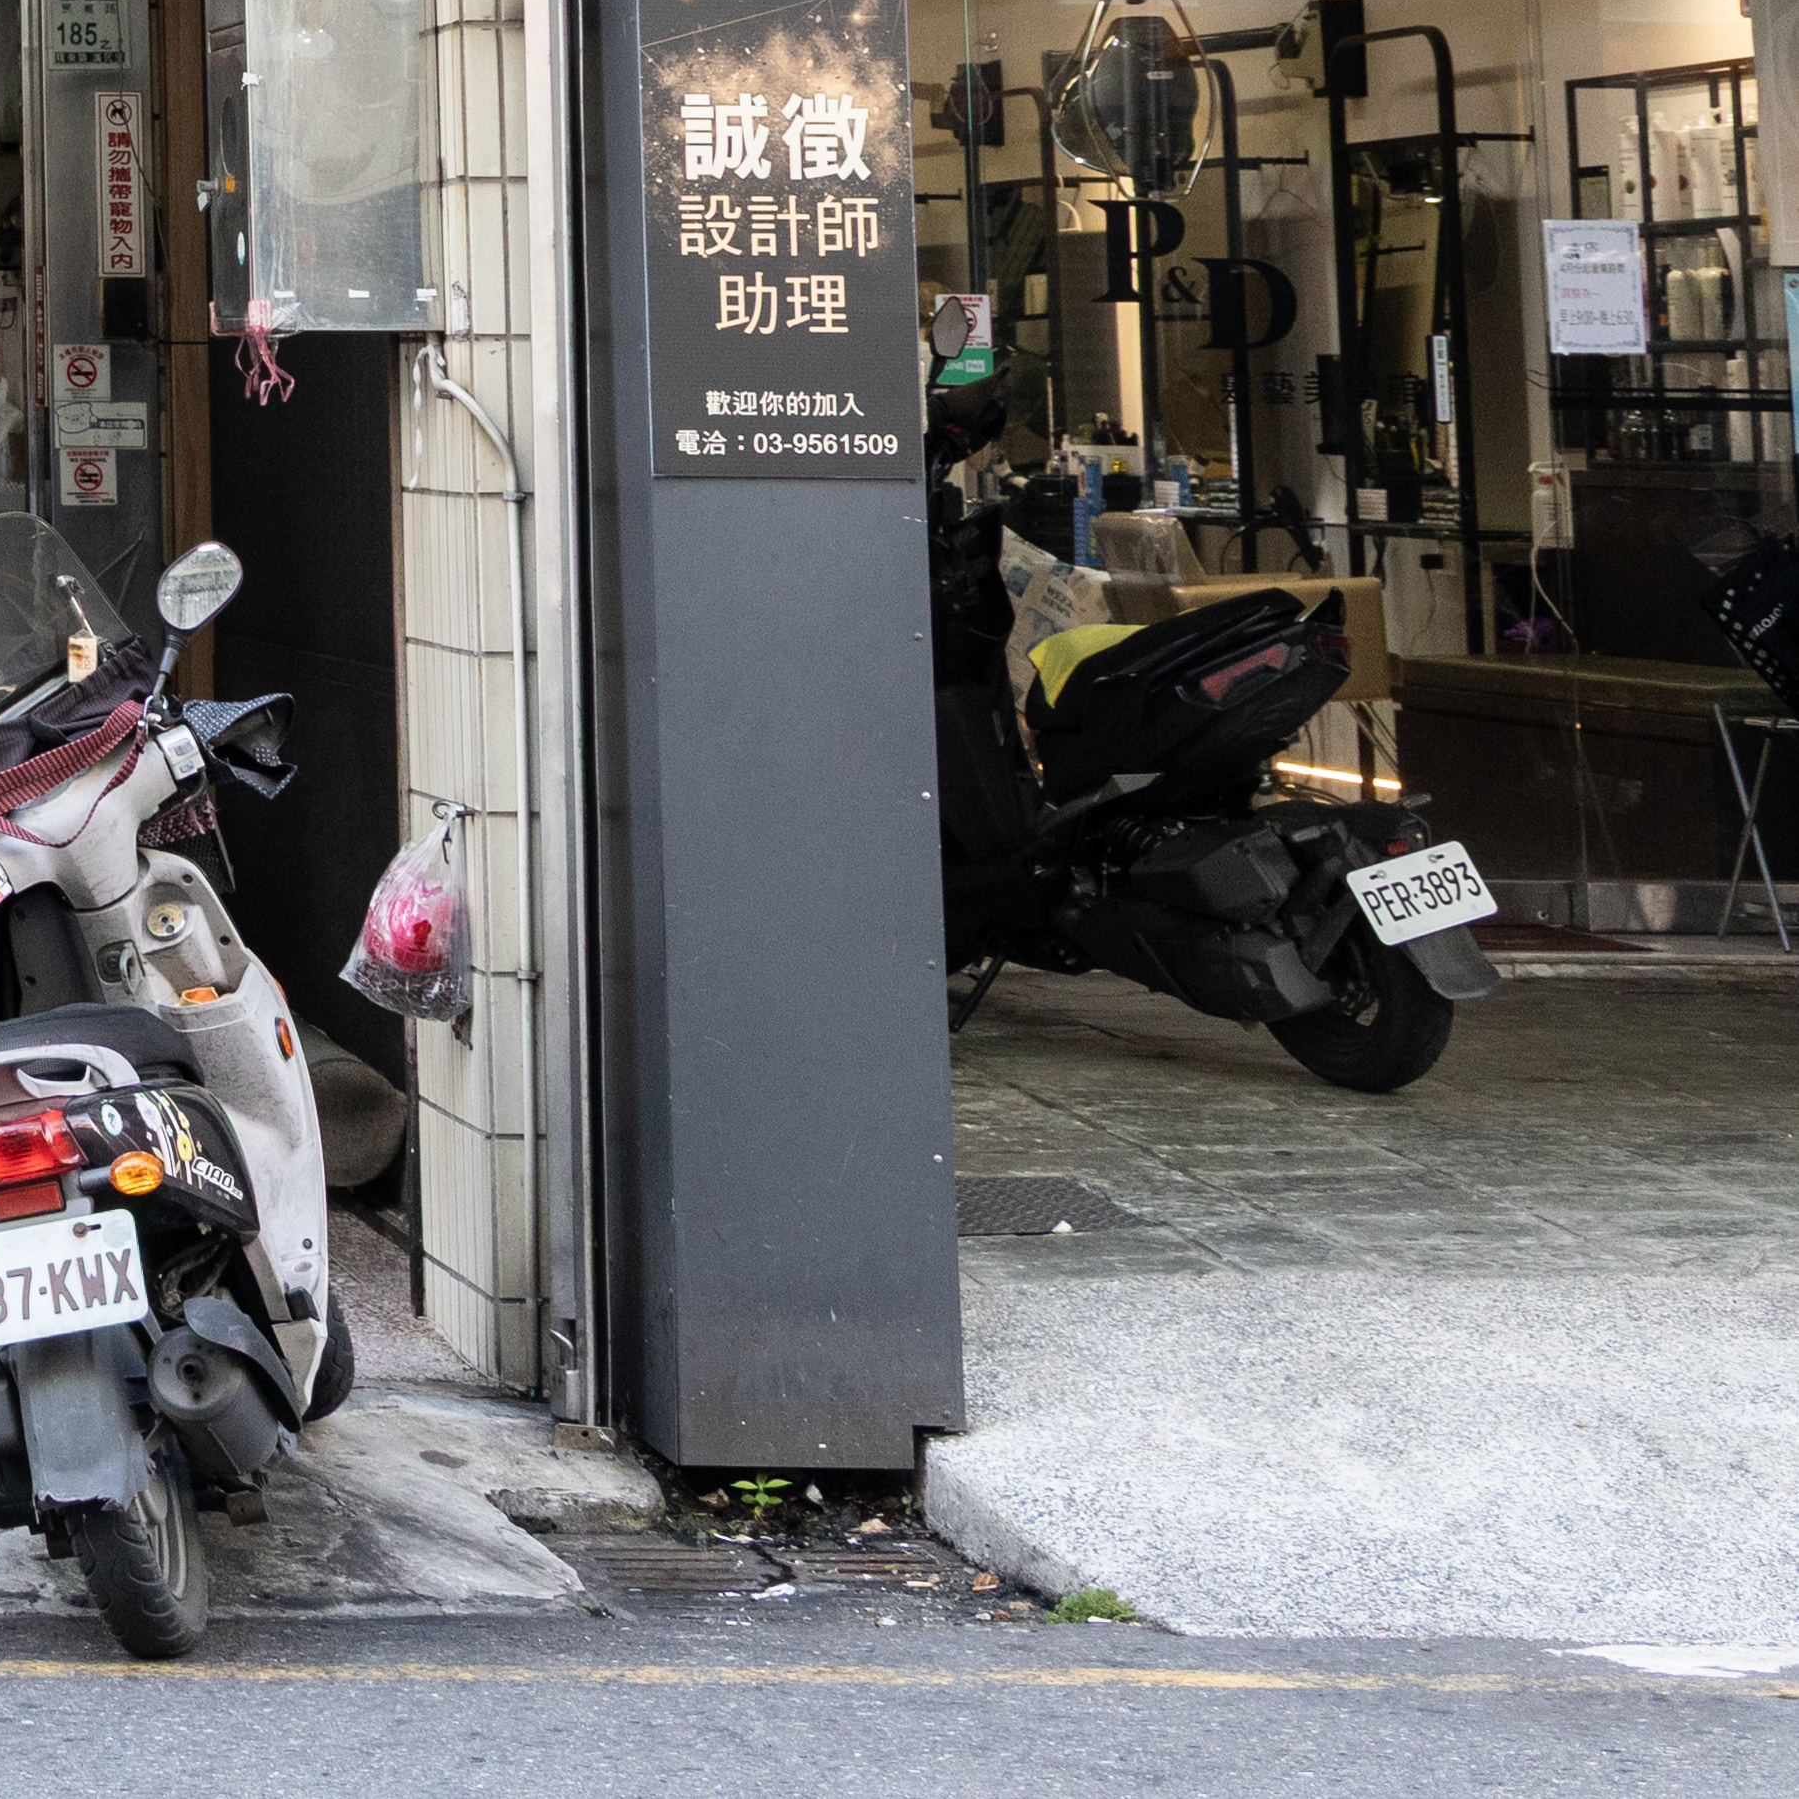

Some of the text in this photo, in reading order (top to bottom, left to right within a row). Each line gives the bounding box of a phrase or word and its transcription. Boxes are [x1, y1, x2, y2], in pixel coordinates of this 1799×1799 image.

[680, 93, 872, 182] 誠徵
[107, 132, 134, 270] 請勿攜帶寵物入內
[678, 194, 879, 258] 設計師
[715, 271, 849, 335] 助理
[705, 390, 865, 418] 歡迎你的加入
